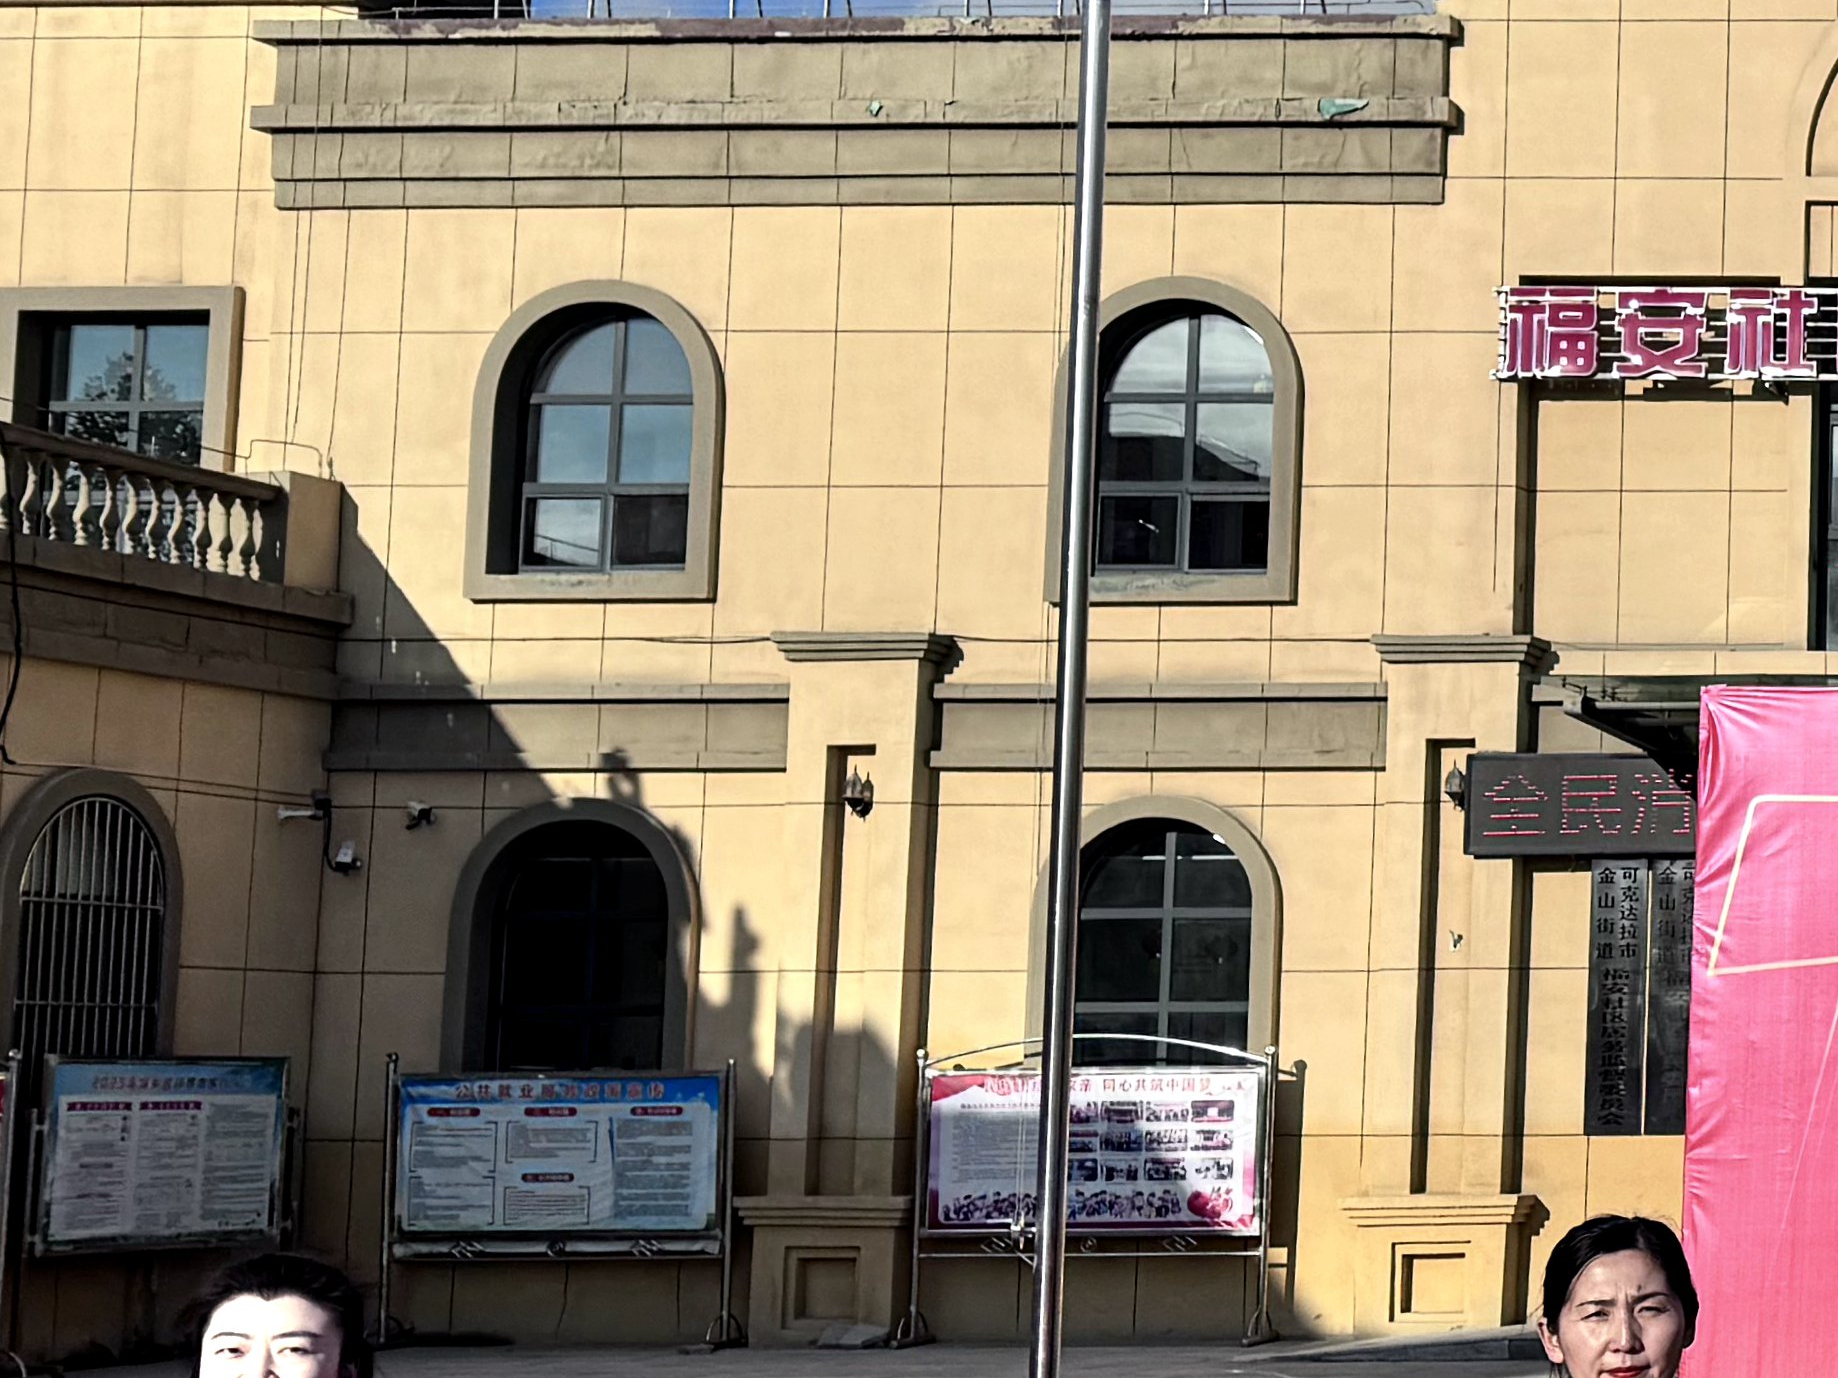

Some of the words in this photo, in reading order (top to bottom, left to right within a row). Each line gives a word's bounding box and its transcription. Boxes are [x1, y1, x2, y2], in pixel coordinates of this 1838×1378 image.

[1595, 866, 1617, 960] 金山街道
[1618, 866, 1641, 959] 可克达拉市
